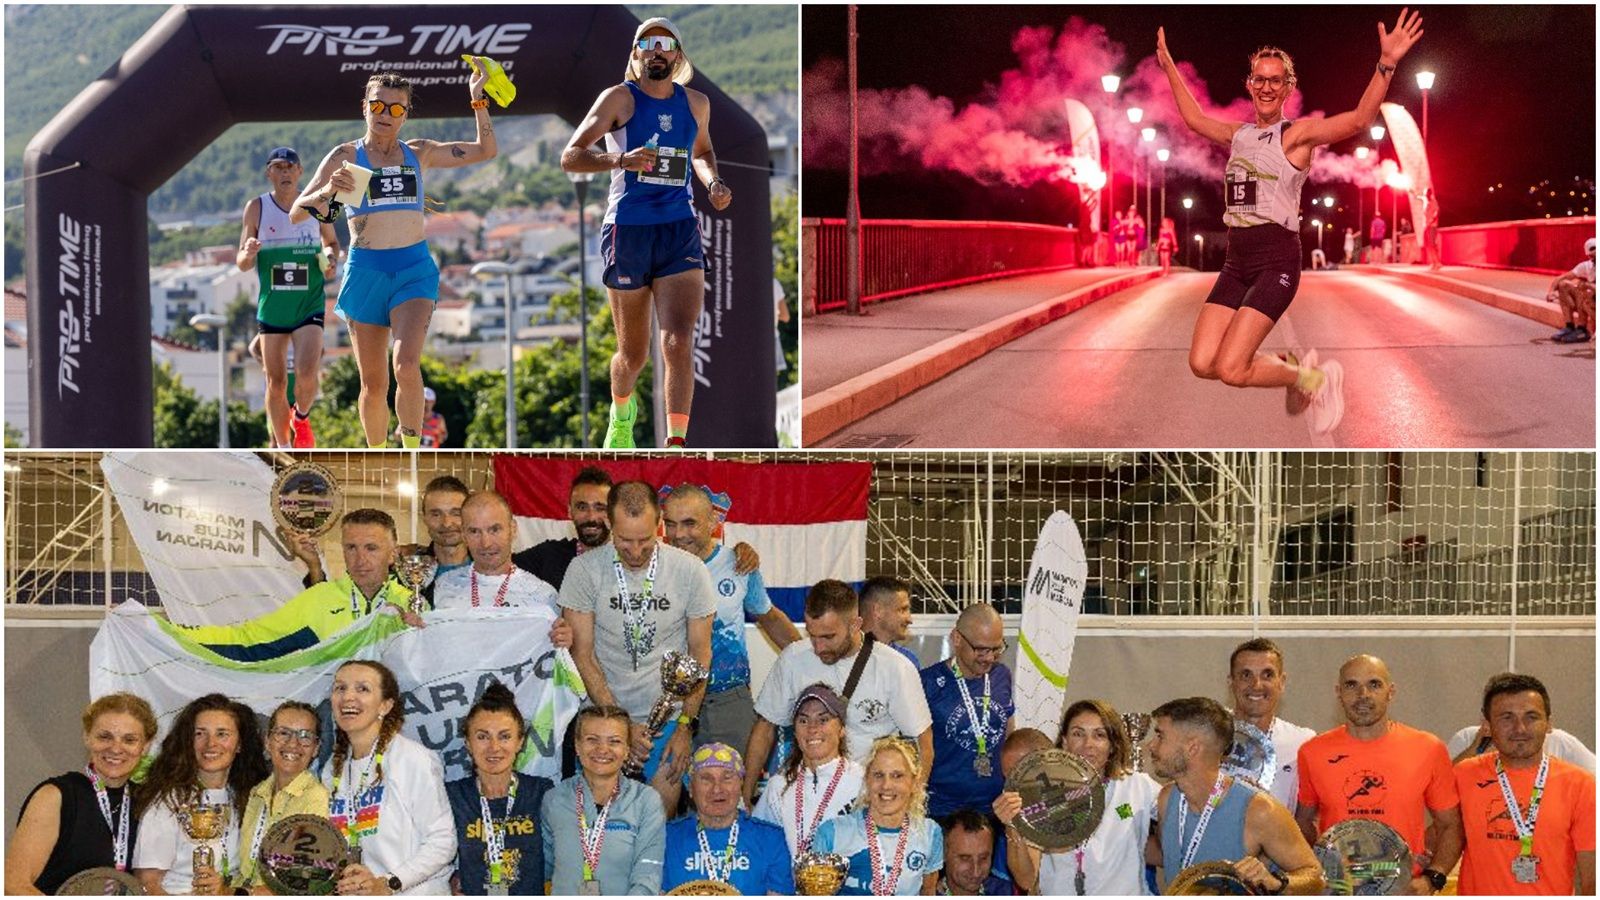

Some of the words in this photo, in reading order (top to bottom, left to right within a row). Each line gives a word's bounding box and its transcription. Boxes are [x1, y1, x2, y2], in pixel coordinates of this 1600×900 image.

[340, 60, 457, 72] professional
[659, 158, 670, 173] 3
[380, 177, 405, 192] 35
[1233, 184, 1246, 200] 15
[83, 225, 92, 260] timing
[714, 219, 723, 255] timing
[284, 271, 294, 282] 6
[83, 263, 92, 343] professional
[714, 257, 723, 338] professional
